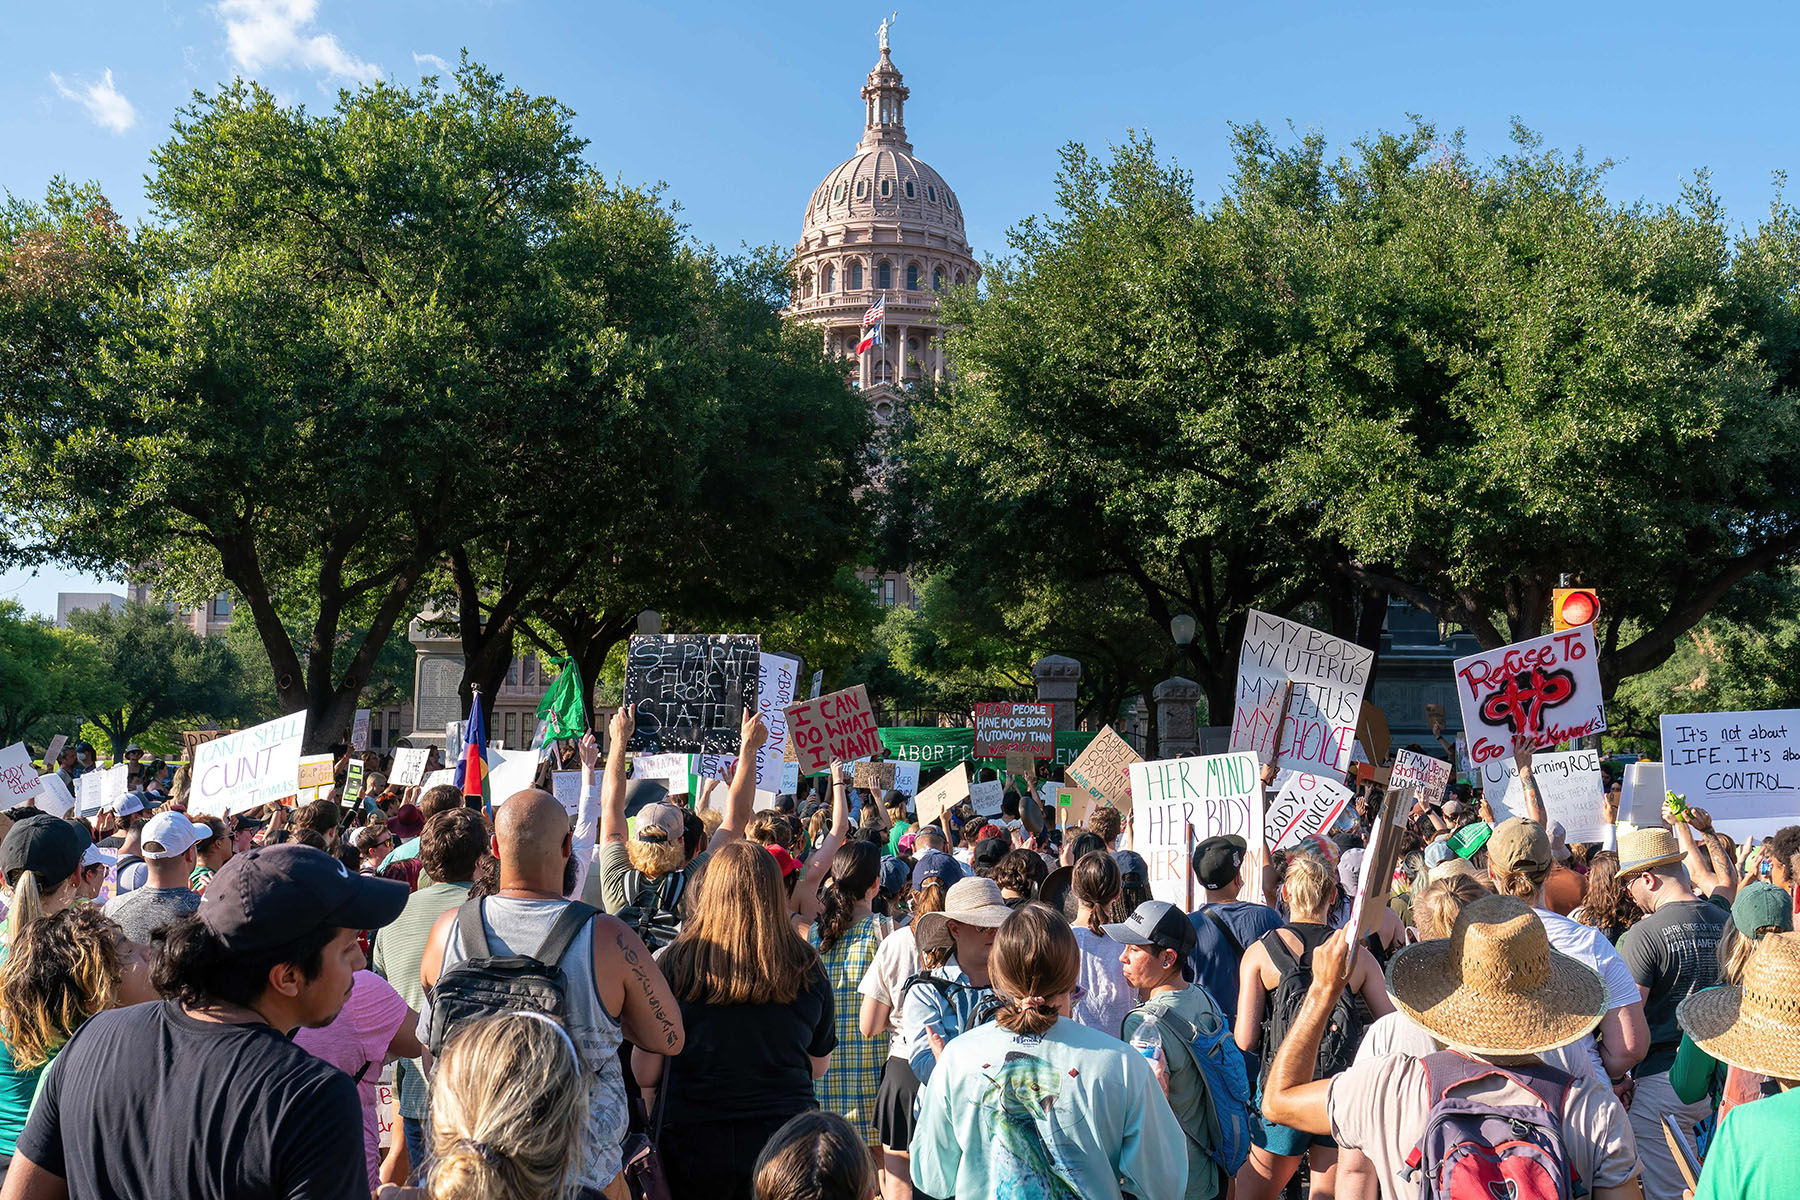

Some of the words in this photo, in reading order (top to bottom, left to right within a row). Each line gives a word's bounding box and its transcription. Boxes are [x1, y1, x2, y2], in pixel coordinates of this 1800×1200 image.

[1254, 614, 1301, 645] MY
[1306, 631, 1372, 666] BODY
[633, 643, 760, 676] SEPARATE
[1241, 639, 1279, 668] MY
[1285, 647, 1364, 685] UTERUS
[1458, 645, 1557, 701] Refuse
[1553, 633, 1587, 662] To
[646, 667, 739, 691] CHURCH
[660, 684, 716, 701] FROM
[788, 706, 811, 727] I
[820, 692, 860, 720] CAN
[977, 704, 1011, 716] DEAD
[1012, 704, 1046, 715] PEOPLE
[1242, 675, 1279, 708] MY
[1288, 682, 1358, 723] FETUS
[636, 698, 735, 735] STATE
[795, 727, 823, 748] DO
[825, 711, 871, 738] WHAT
[976, 716, 1001, 730] HAVE
[1001, 717, 1026, 730] MORE
[1026, 717, 1052, 729] BODILY
[252, 719, 302, 747] SPELL
[807, 746, 828, 768] I
[829, 727, 879, 761] WANT
[976, 729, 1027, 742] AUTONOMY
[1028, 731, 1052, 743] THAN
[1102, 732, 1140, 764] ABBOTT
[1233, 706, 1274, 753] MY
[1272, 716, 1356, 774] CHOICE
[1675, 726, 1708, 743] It's
[1721, 724, 1741, 741] not
[1748, 724, 1788, 740] about
[988, 743, 1045, 756] WOMEN!
[1095, 740, 1123, 769] CRUZ
[1411, 755, 1428, 772] My
[1472, 736, 1505, 763] Go
[1568, 752, 1600, 773] ROE
[1734, 747, 1771, 762] It's
[1782, 747, 1800, 762] abo
[13, 776, 41, 794] CHOICE
[201, 743, 281, 797] CUNT
[1070, 768, 1091, 789] HAVE
[1089, 786, 1105, 800] GOT
[1079, 759, 1120, 800] PAXTON
[1088, 750, 1128, 789] CORNYN
[1145, 761, 1200, 800] HER
[1206, 755, 1255, 798] MIND
[1149, 802, 1199, 845] HER
[1206, 796, 1251, 839] BODY
